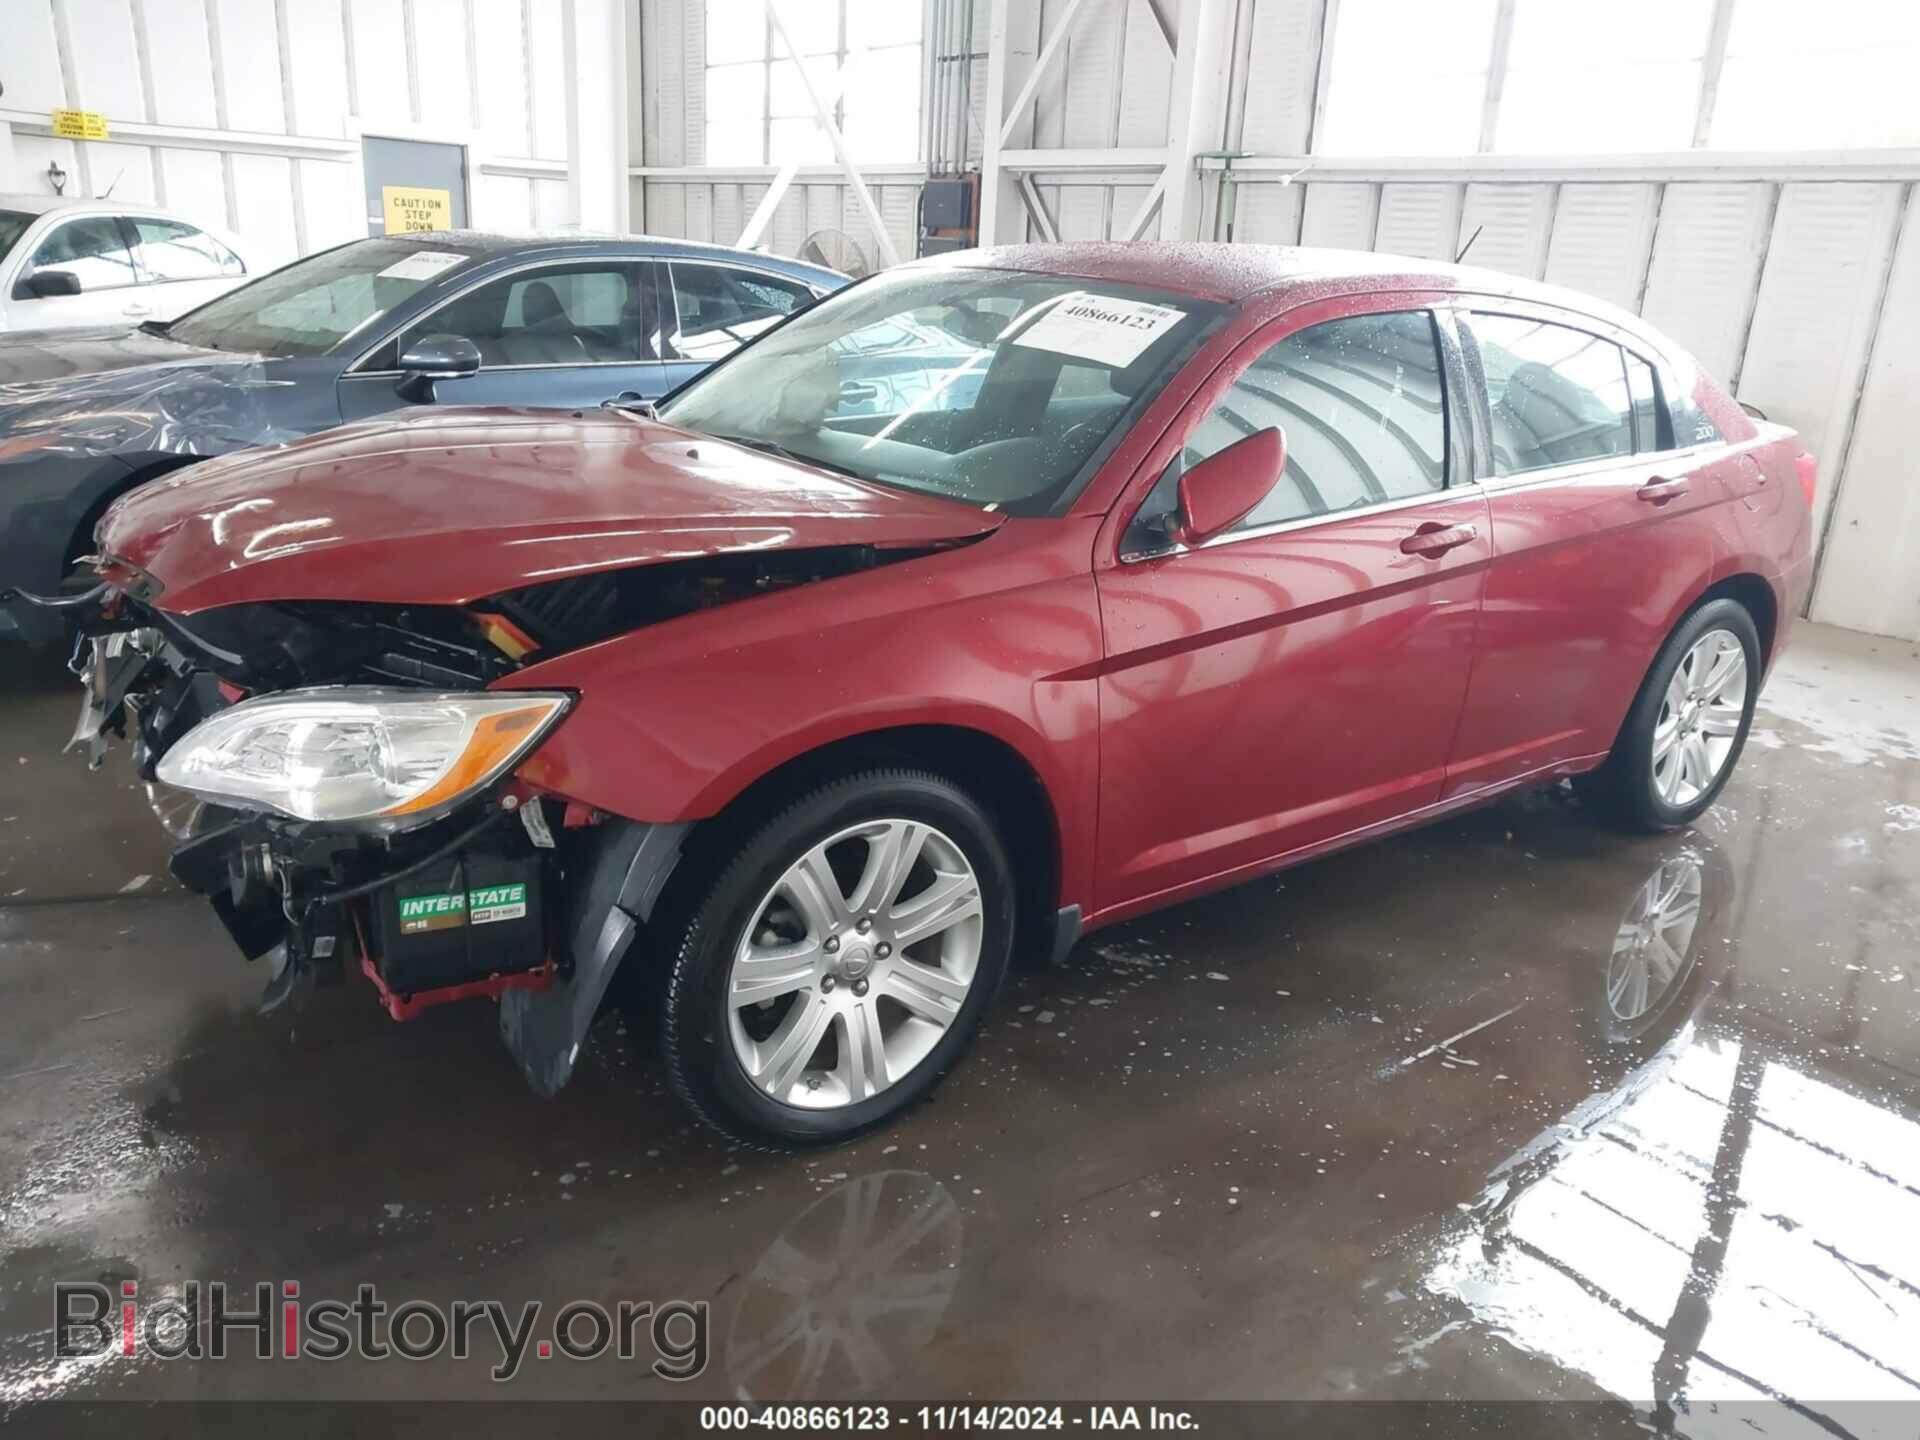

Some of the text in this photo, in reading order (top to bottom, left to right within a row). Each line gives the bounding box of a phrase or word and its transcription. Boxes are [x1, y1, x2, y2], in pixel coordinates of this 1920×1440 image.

[393, 197, 442, 209] CAUTION
[405, 209, 432, 220] STEP
[405, 220, 433, 232] DOWN
[1064, 304, 1156, 330] 40866123
